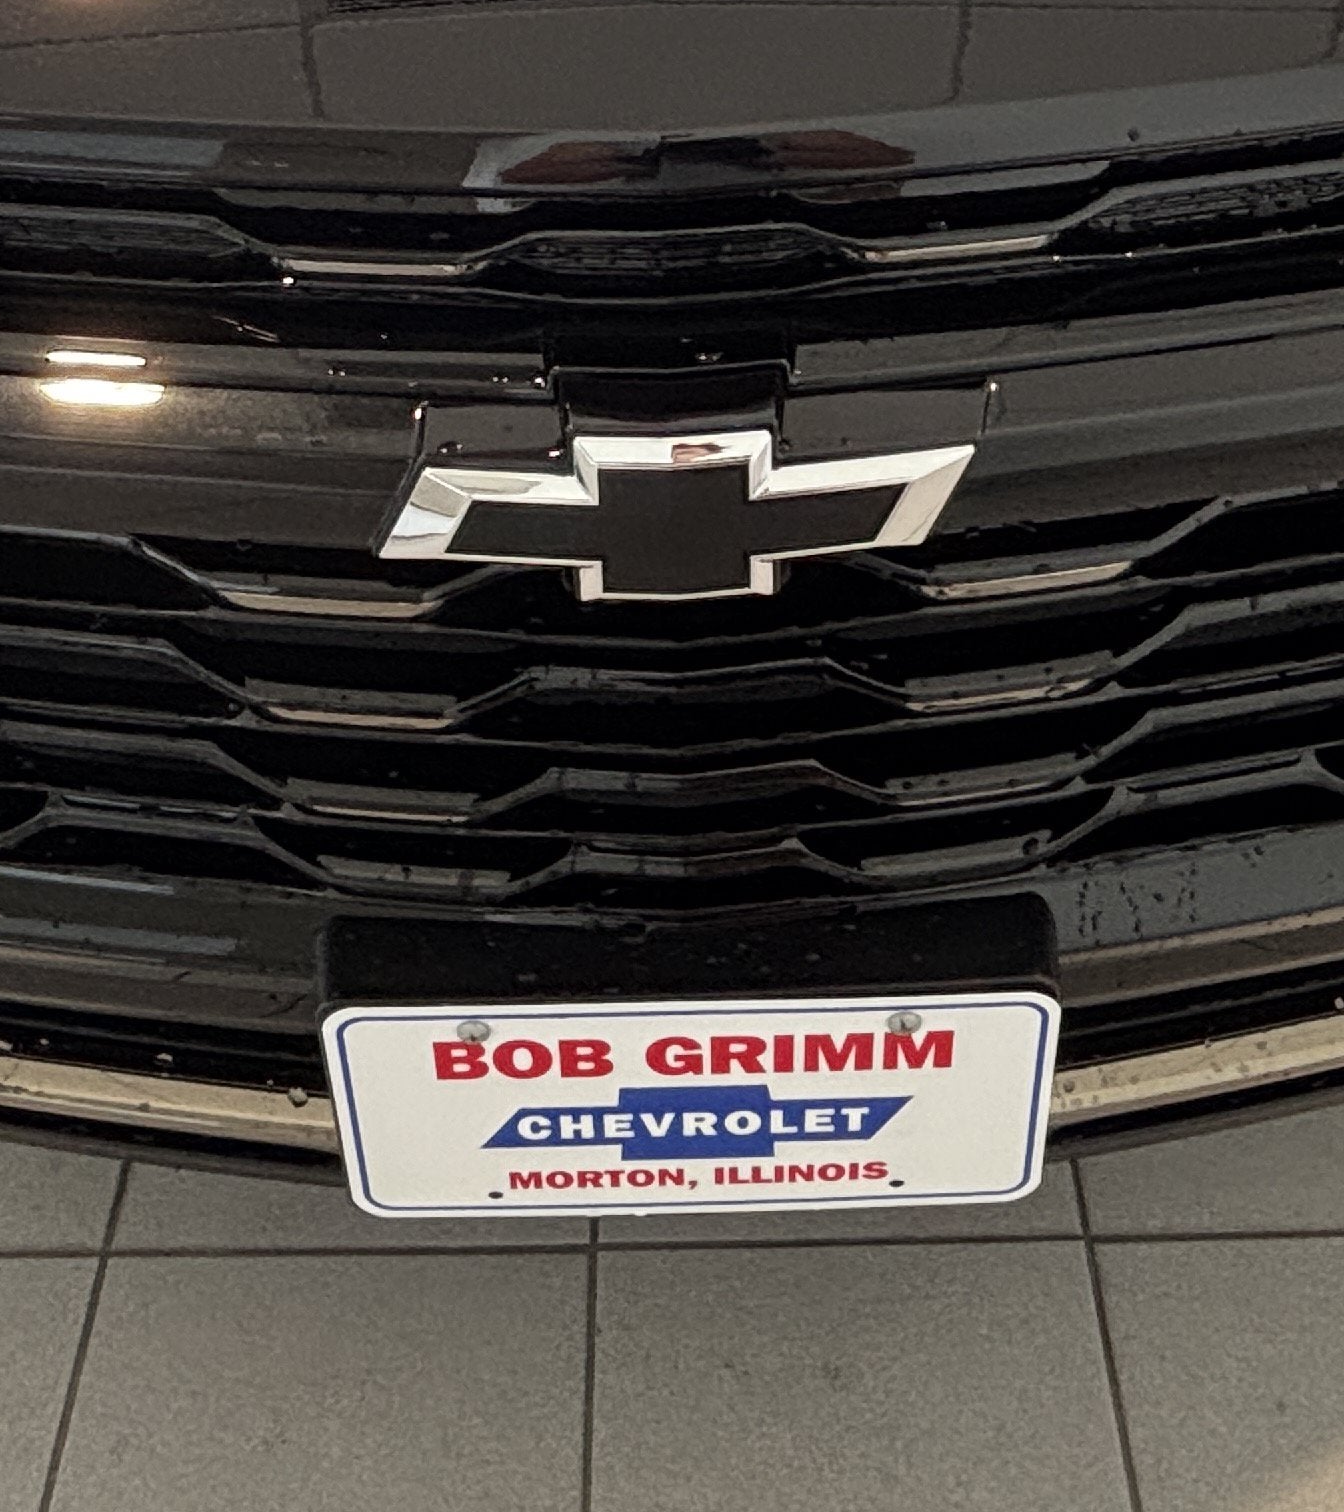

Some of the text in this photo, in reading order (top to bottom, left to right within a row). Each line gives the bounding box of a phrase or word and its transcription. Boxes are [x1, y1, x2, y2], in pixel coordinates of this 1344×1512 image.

[432, 1030, 955, 1081] BOB GRIMM
[517, 1106, 871, 1141] CHEVROLET
[508, 1161, 890, 1191] MORTON, ILLINOIS
